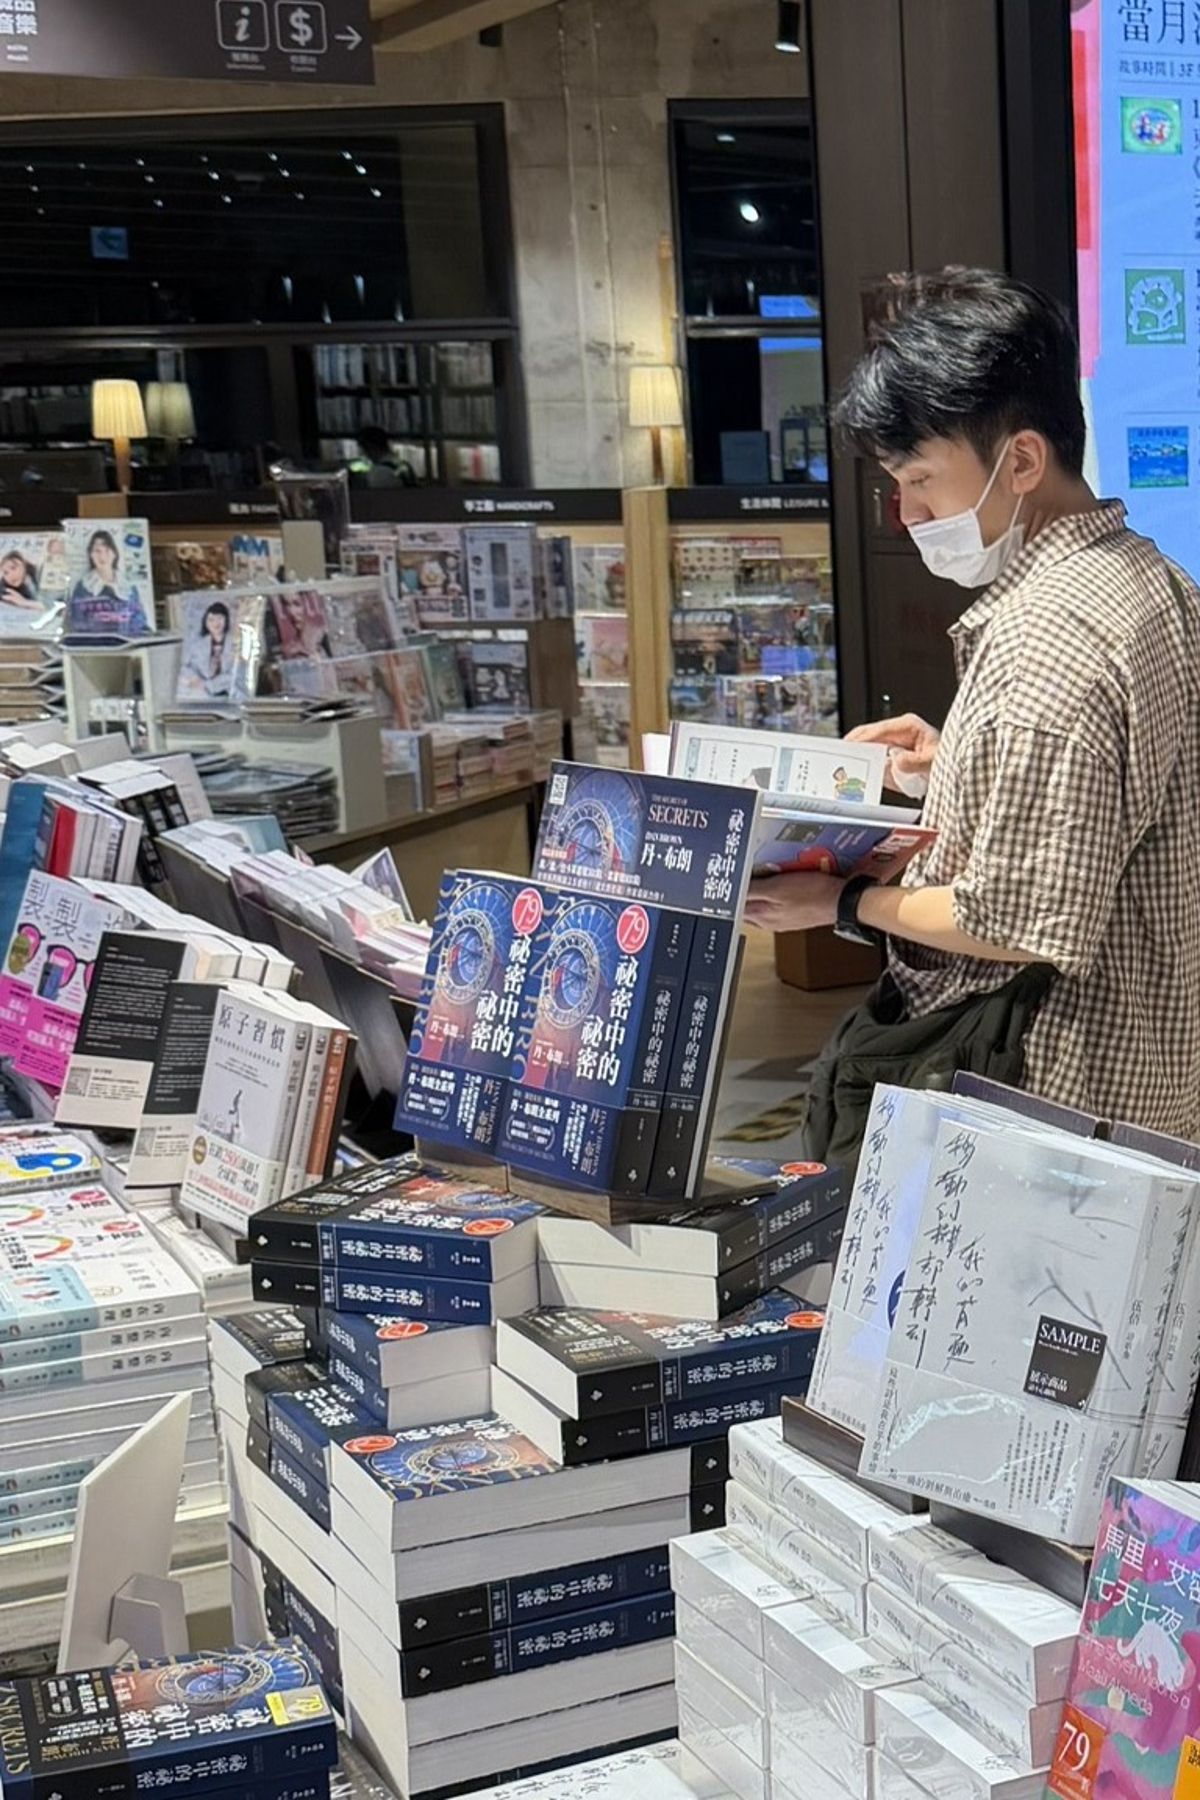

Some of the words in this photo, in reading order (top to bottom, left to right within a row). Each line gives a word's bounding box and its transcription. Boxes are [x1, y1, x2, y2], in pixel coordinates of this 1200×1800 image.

[647, 804, 710, 829] SECRETS
[620, 908, 646, 947] 79
[217, 1003, 286, 1053] 原子習慣
[1038, 1322, 1102, 1355] SAMPLE
[1095, 1567, 1184, 1644] 七天七夜
[1104, 1645, 1138, 1676] Seven
[1079, 1657, 1108, 1686] Maali
[1106, 1678, 1154, 1718] Almeida
[1058, 1720, 1091, 1773] 79
